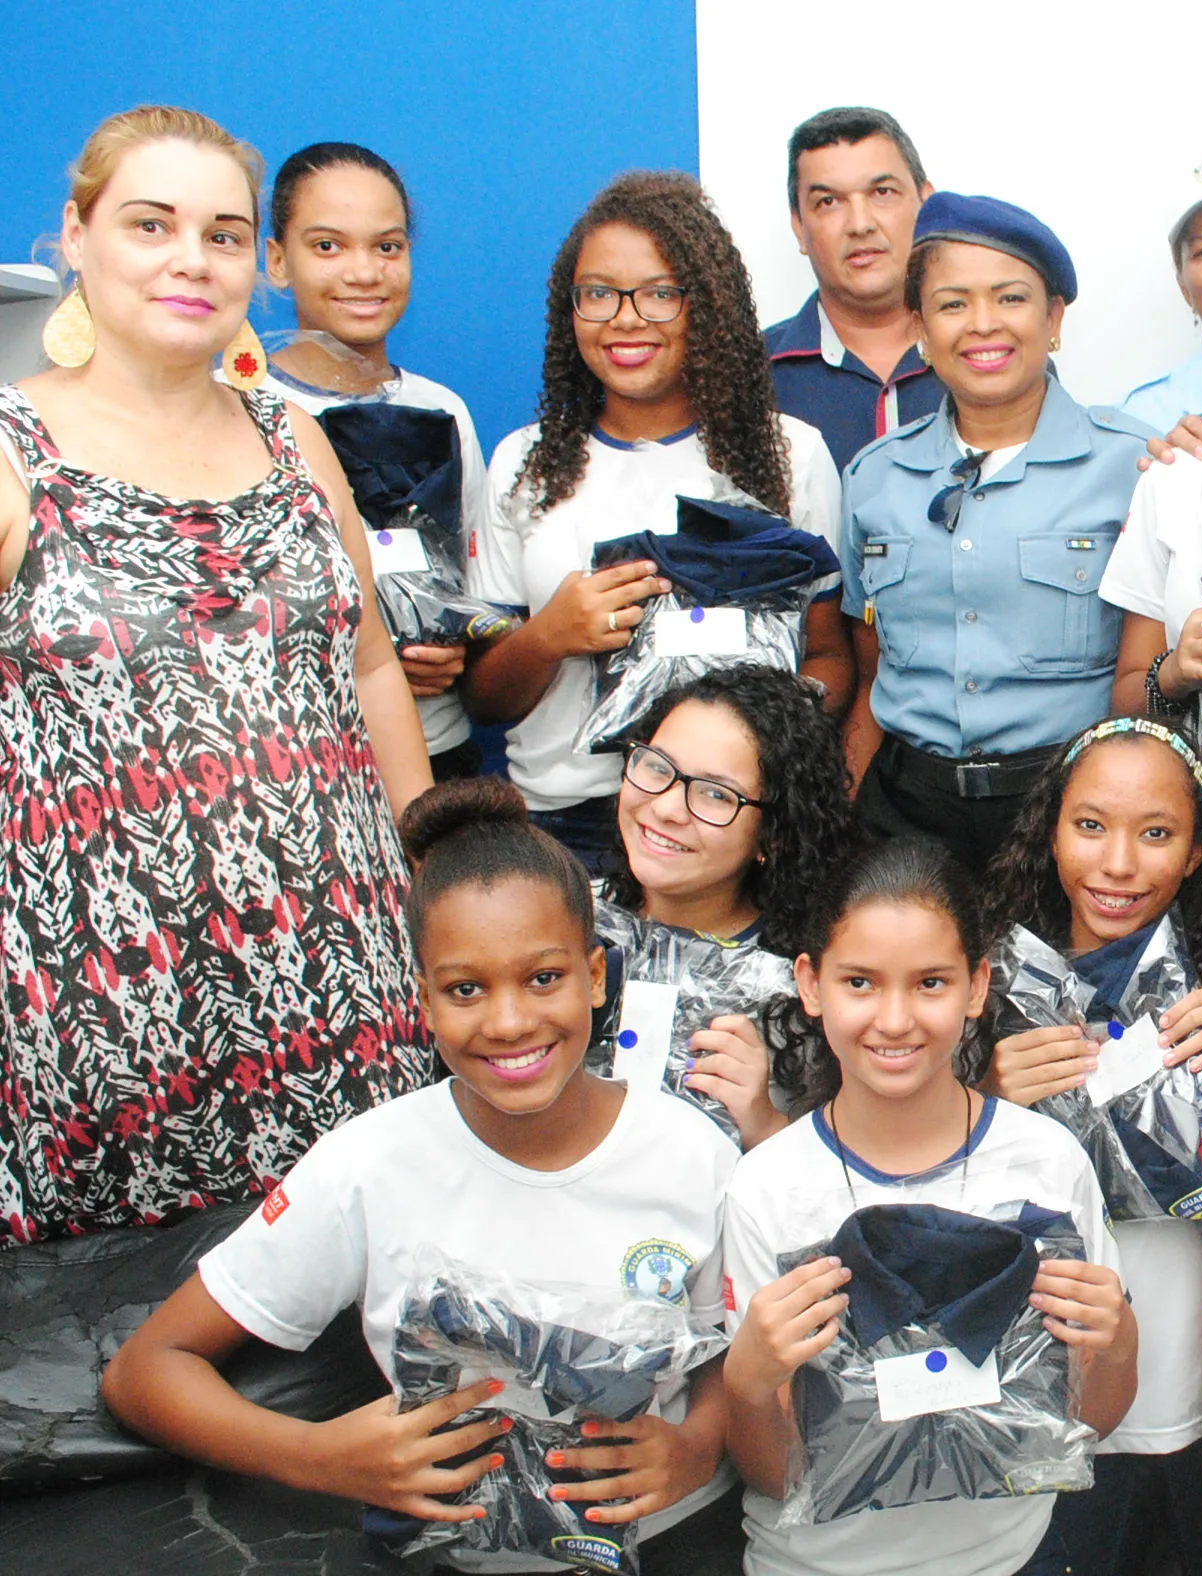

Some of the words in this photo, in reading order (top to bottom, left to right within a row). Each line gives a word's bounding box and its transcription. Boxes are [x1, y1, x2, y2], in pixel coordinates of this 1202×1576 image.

[628, 1246, 660, 1273] GUARDA
[662, 1245, 694, 1267] MIRIM
[567, 1540, 617, 1558] GUARDA
[581, 1551, 619, 1570] MUNICIPA
